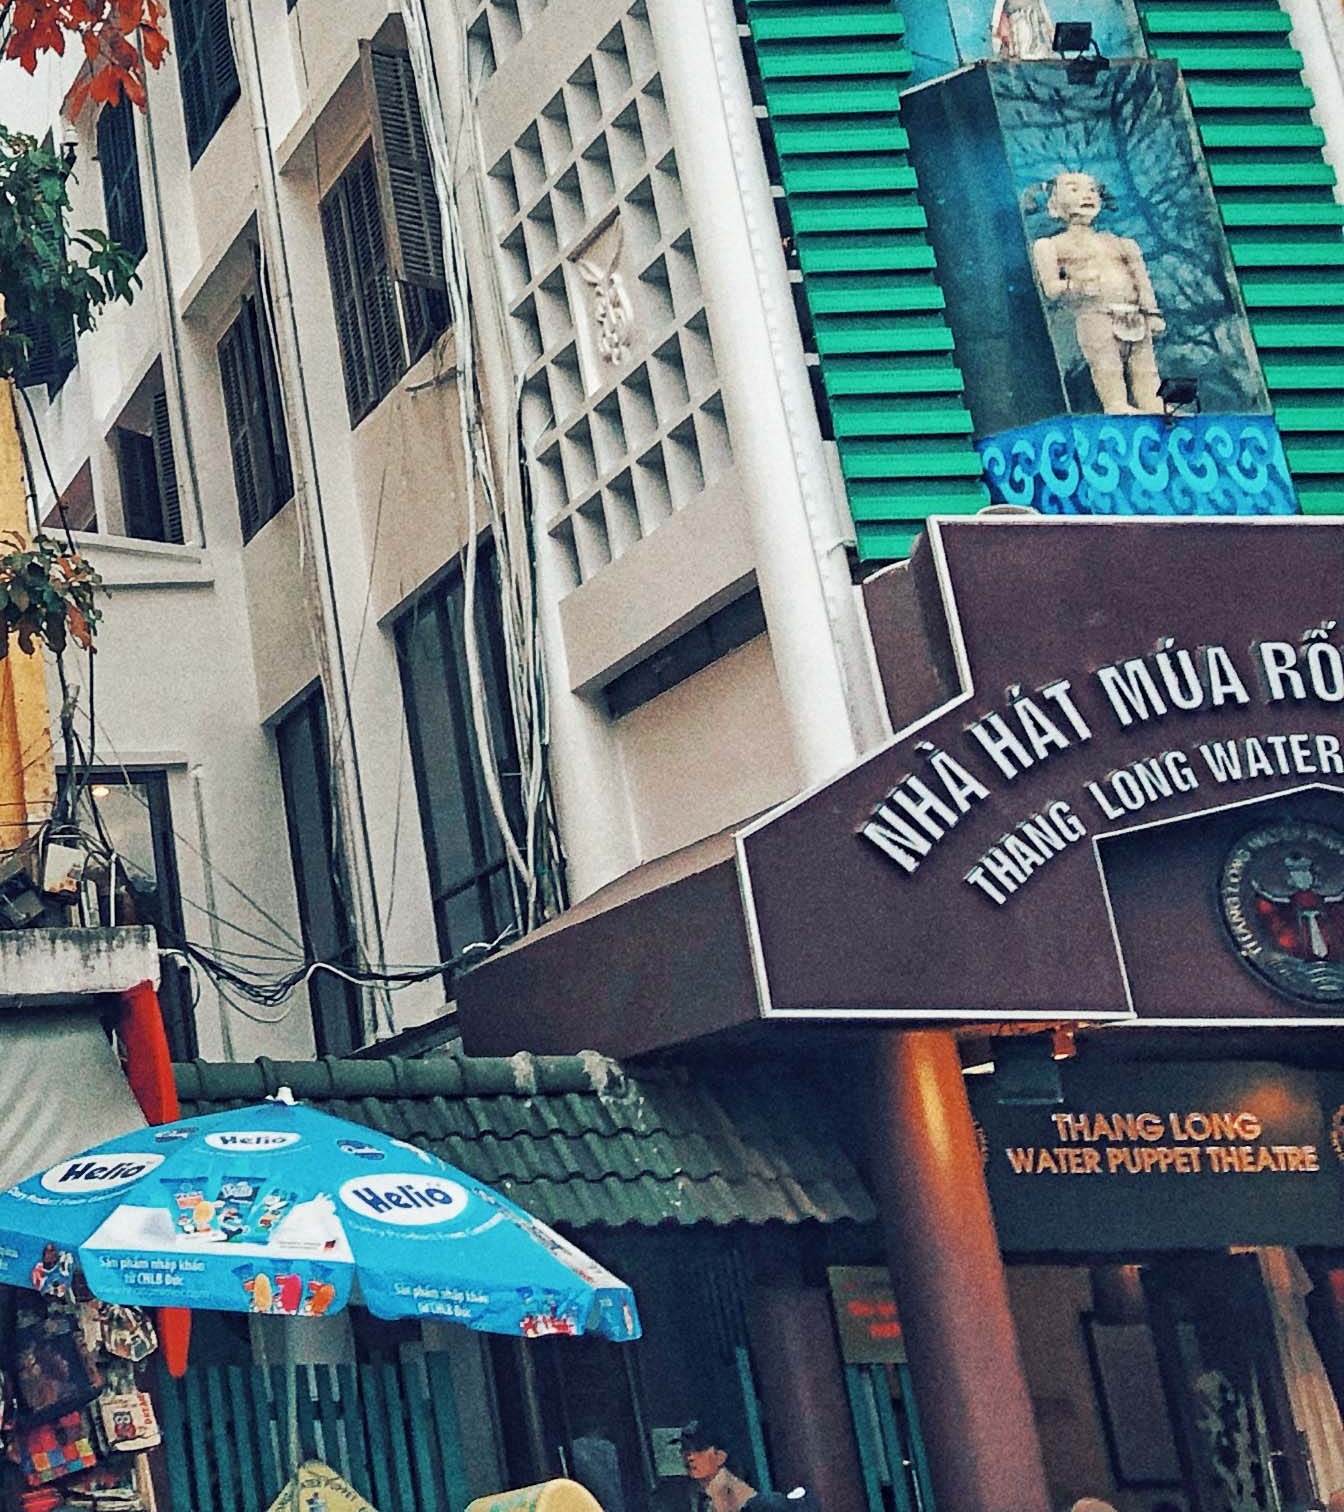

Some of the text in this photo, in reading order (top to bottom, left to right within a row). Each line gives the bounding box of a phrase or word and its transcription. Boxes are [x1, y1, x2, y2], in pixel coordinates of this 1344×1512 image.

[861, 741, 990, 874] NHÀ
[968, 679, 1092, 780] HÁT
[1097, 637, 1250, 727] MÚA
[964, 734, 1344, 905] THANG LONG WATER
[1006, 1145, 1320, 1174] WATER PUPPET THEATRE
[1052, 1112, 1263, 1142] THANG LONG
